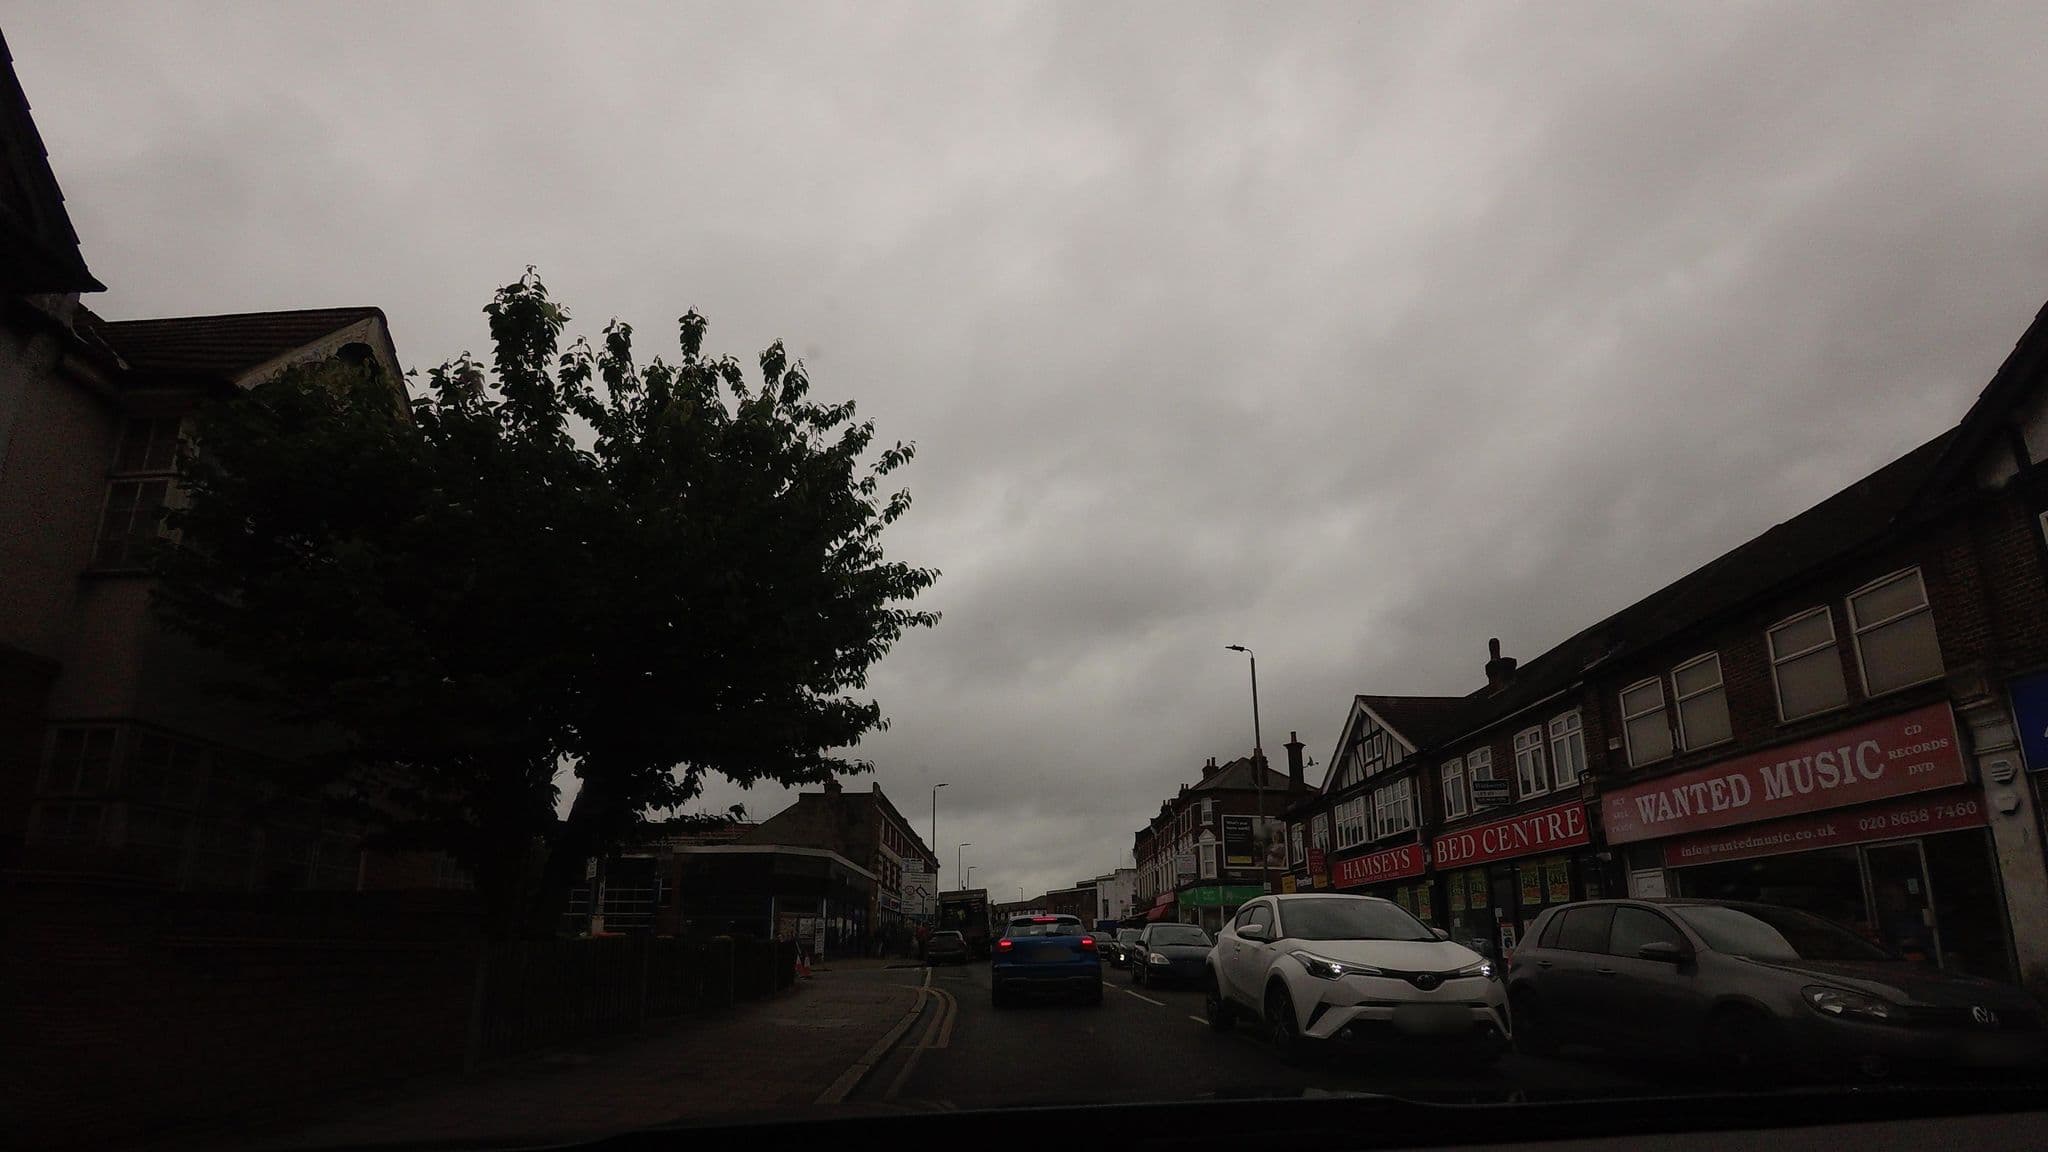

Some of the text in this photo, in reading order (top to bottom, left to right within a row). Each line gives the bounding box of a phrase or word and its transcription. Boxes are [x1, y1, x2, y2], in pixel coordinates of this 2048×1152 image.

[1904, 724, 1922, 737] CD
[1887, 737, 1949, 761] RECORDS
[1635, 739, 1886, 824] WANTED MUSIC
[1908, 761, 1936, 776] DVD
[1859, 816, 1886, 831] 020
[1935, 801, 1977, 820] 7460
[1434, 807, 1586, 864] BED CENTRE
[1343, 848, 1411, 880] HAMSEYS
